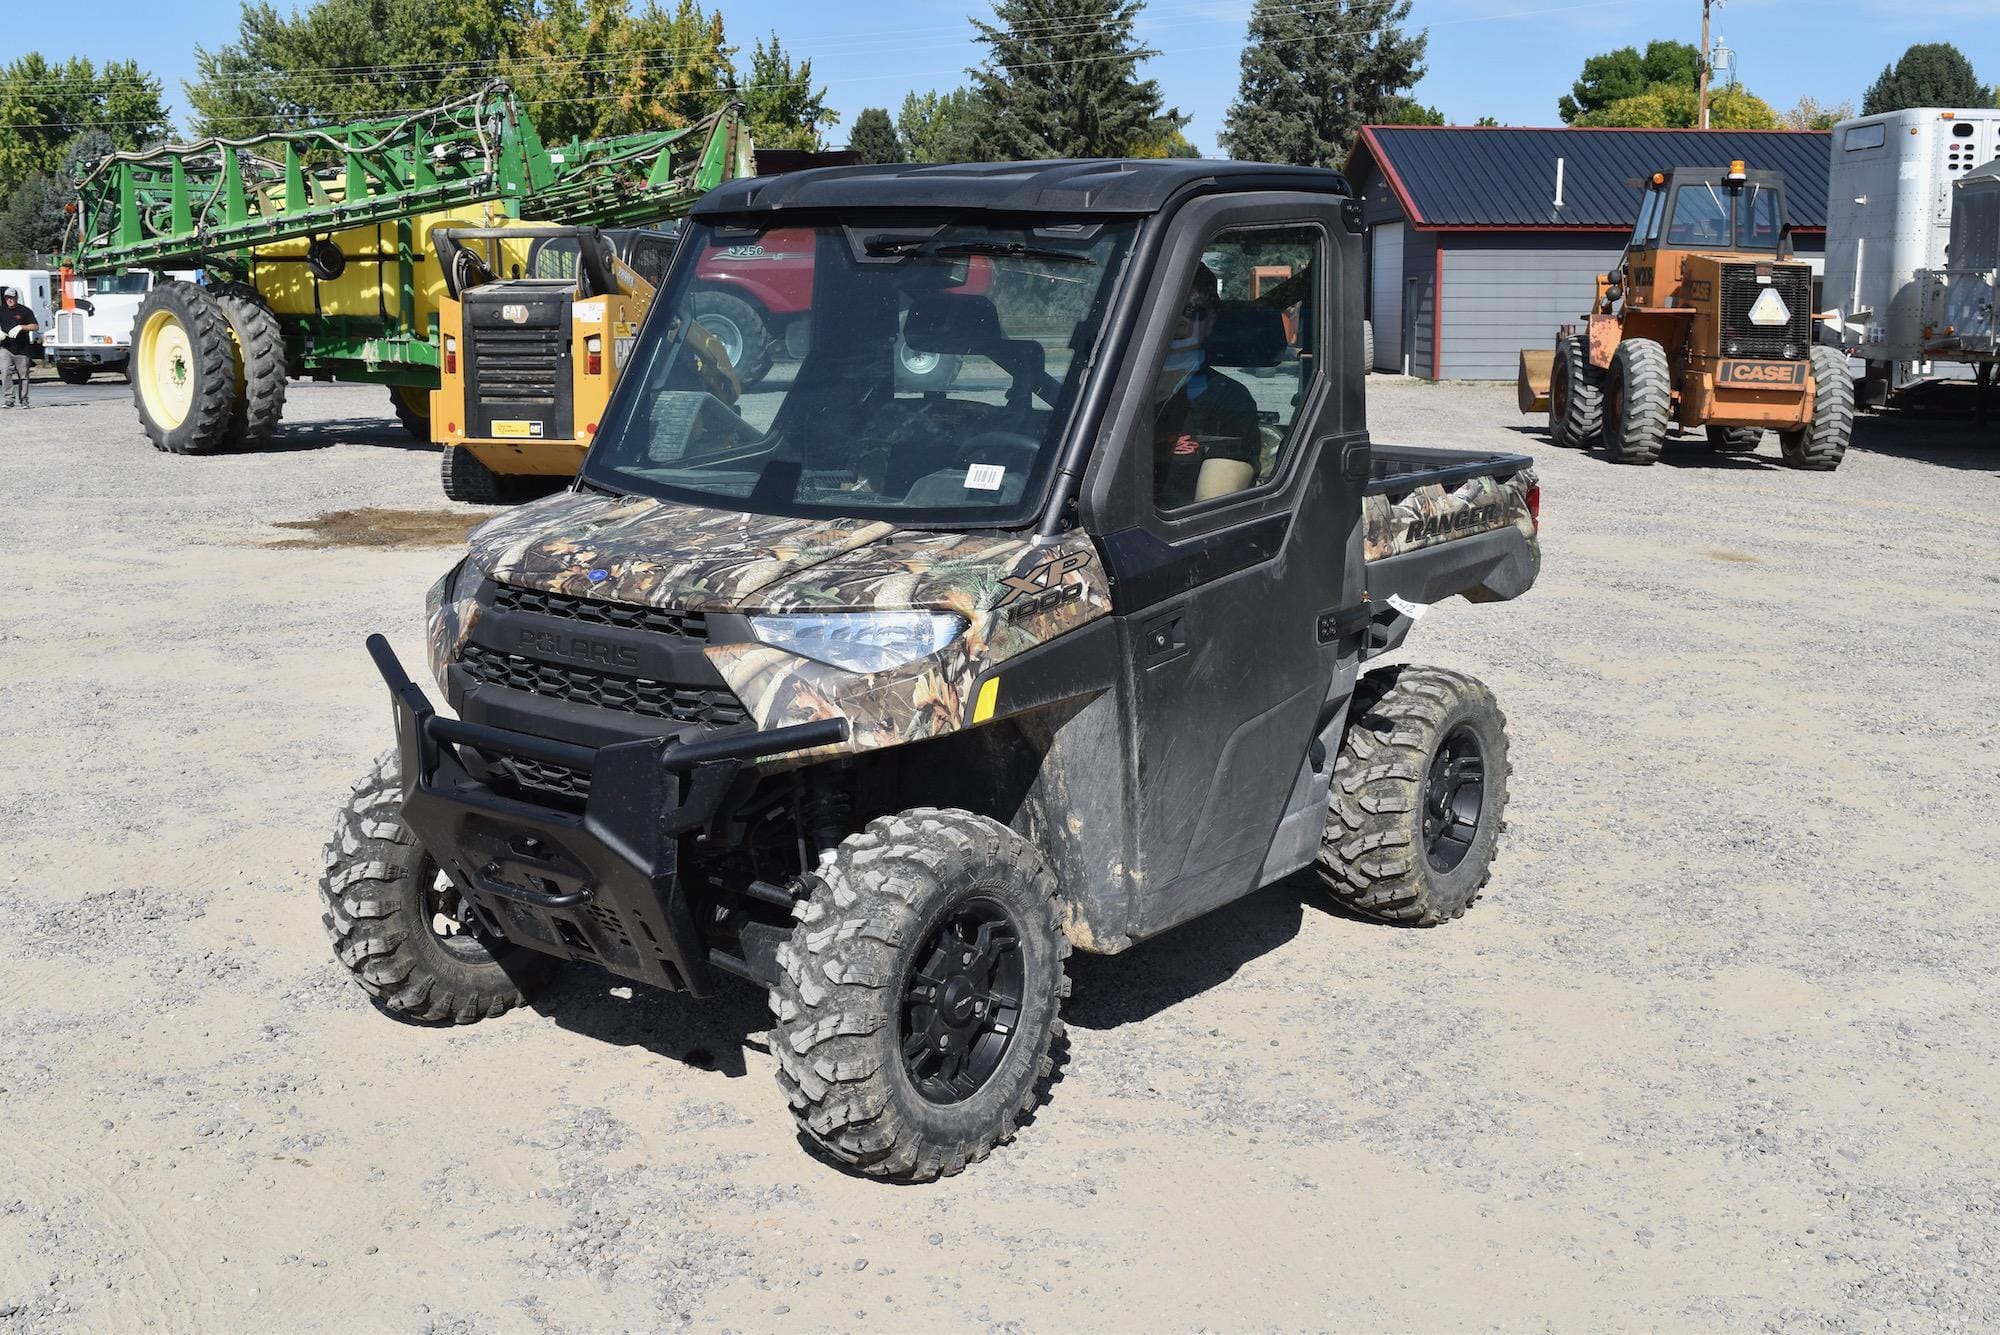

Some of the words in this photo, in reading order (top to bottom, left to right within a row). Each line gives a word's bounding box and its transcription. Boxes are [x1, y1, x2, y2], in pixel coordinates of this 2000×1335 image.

[502, 304, 524, 320] CAT
[1733, 364, 1793, 381] CASE
[1406, 503, 1498, 543] RANGER
[986, 549, 1093, 612] XP
[1008, 582, 1083, 624] 1000
[519, 628, 639, 669] POLARIS
